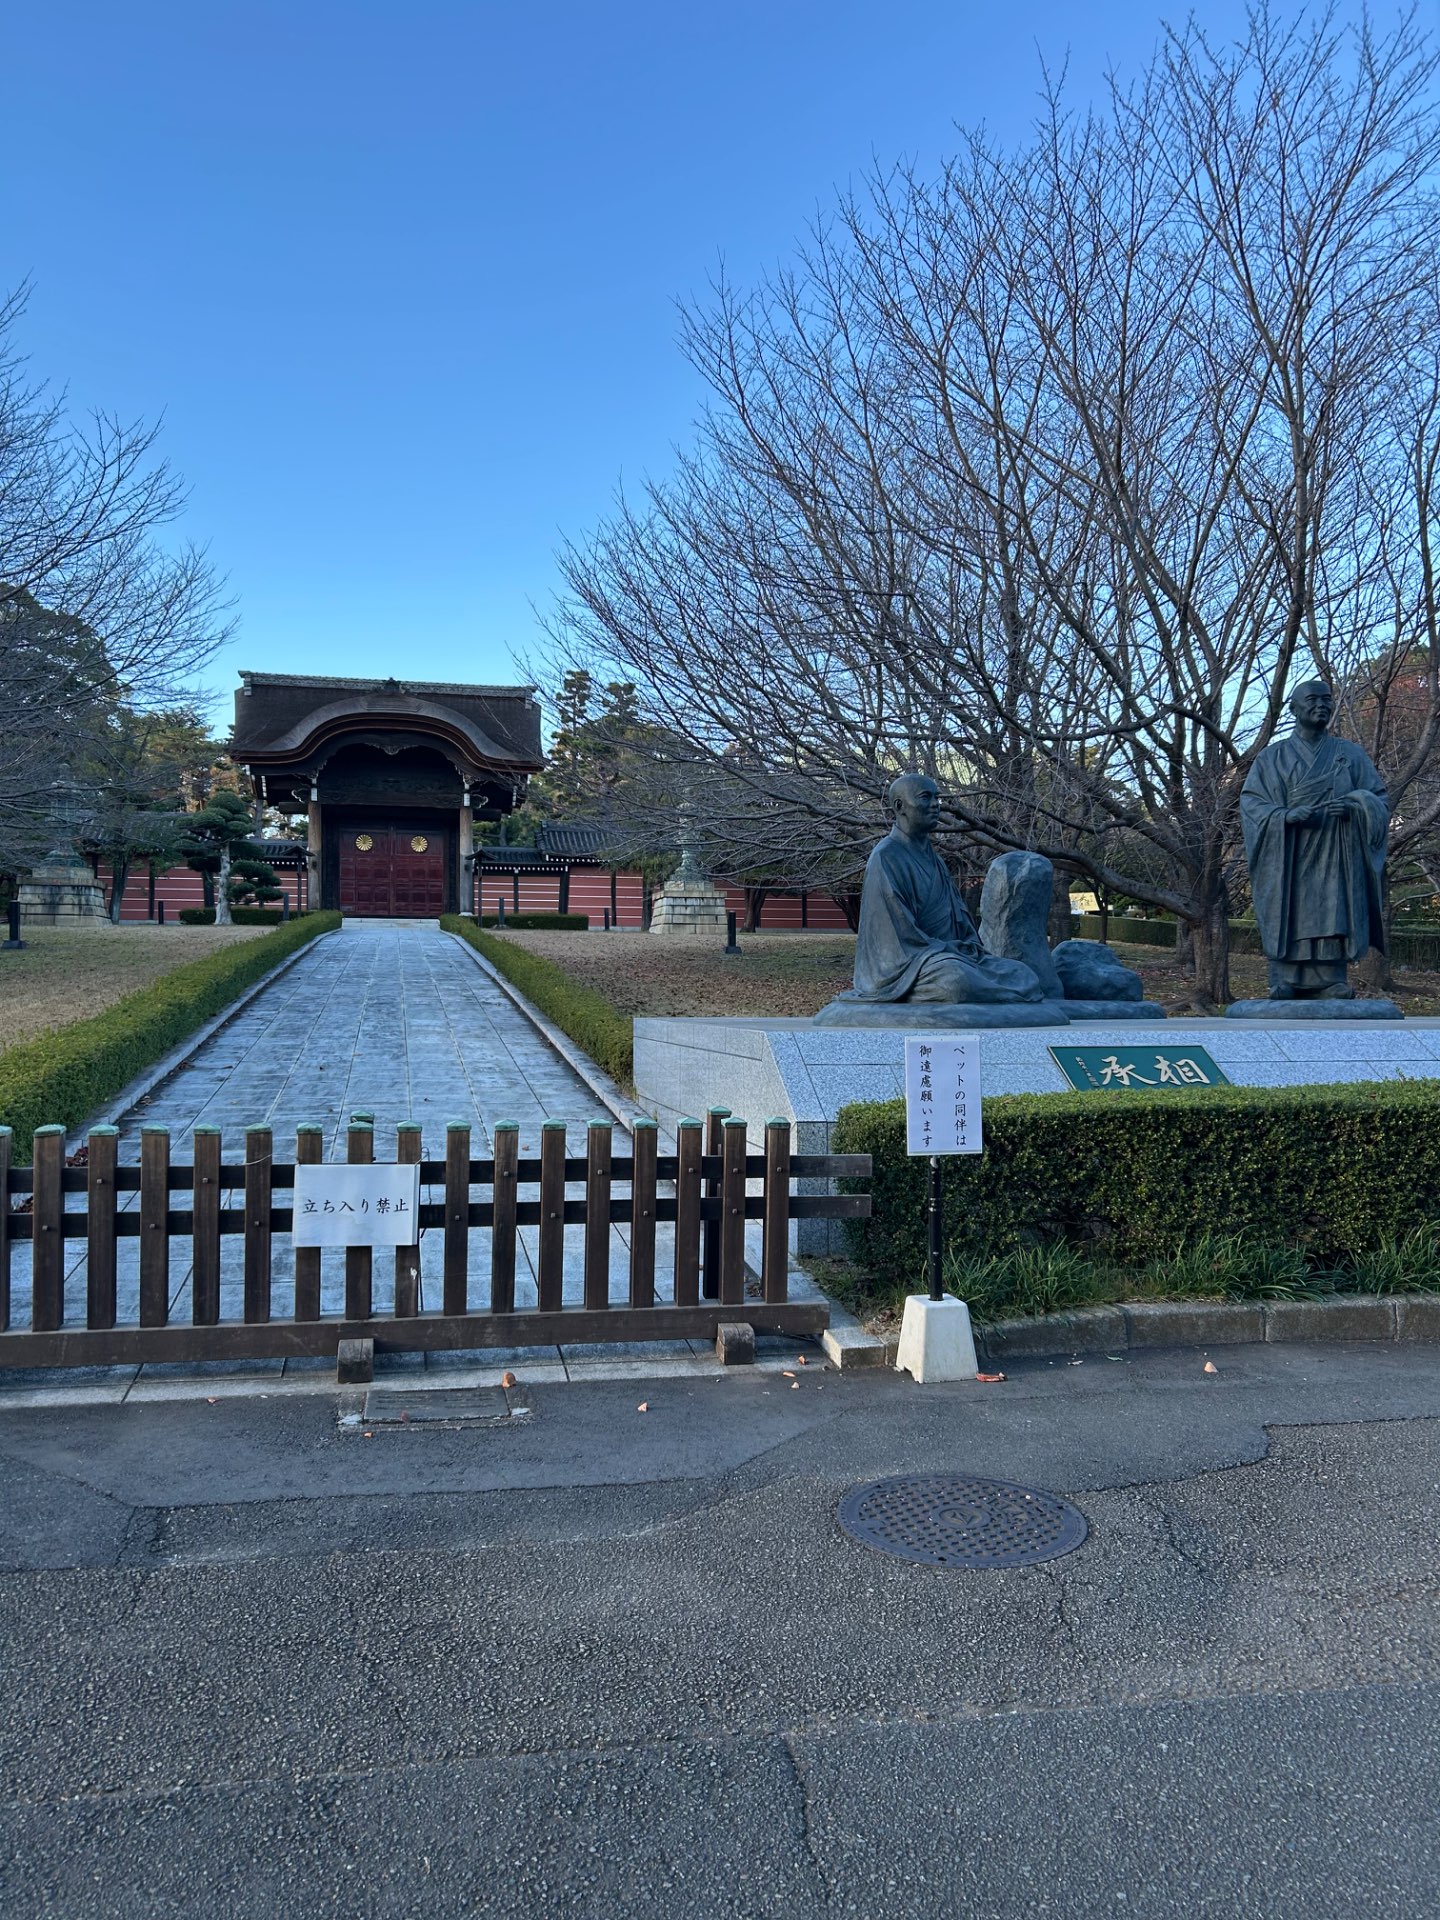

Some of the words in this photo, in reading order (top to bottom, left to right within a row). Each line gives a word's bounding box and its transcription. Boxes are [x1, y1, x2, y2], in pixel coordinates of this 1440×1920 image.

[919, 1045, 933, 1148] 御遠慮願います
[953, 1045, 967, 1146] ペットの同伴は
[302, 1197, 409, 1214] 立ち入り禁止
